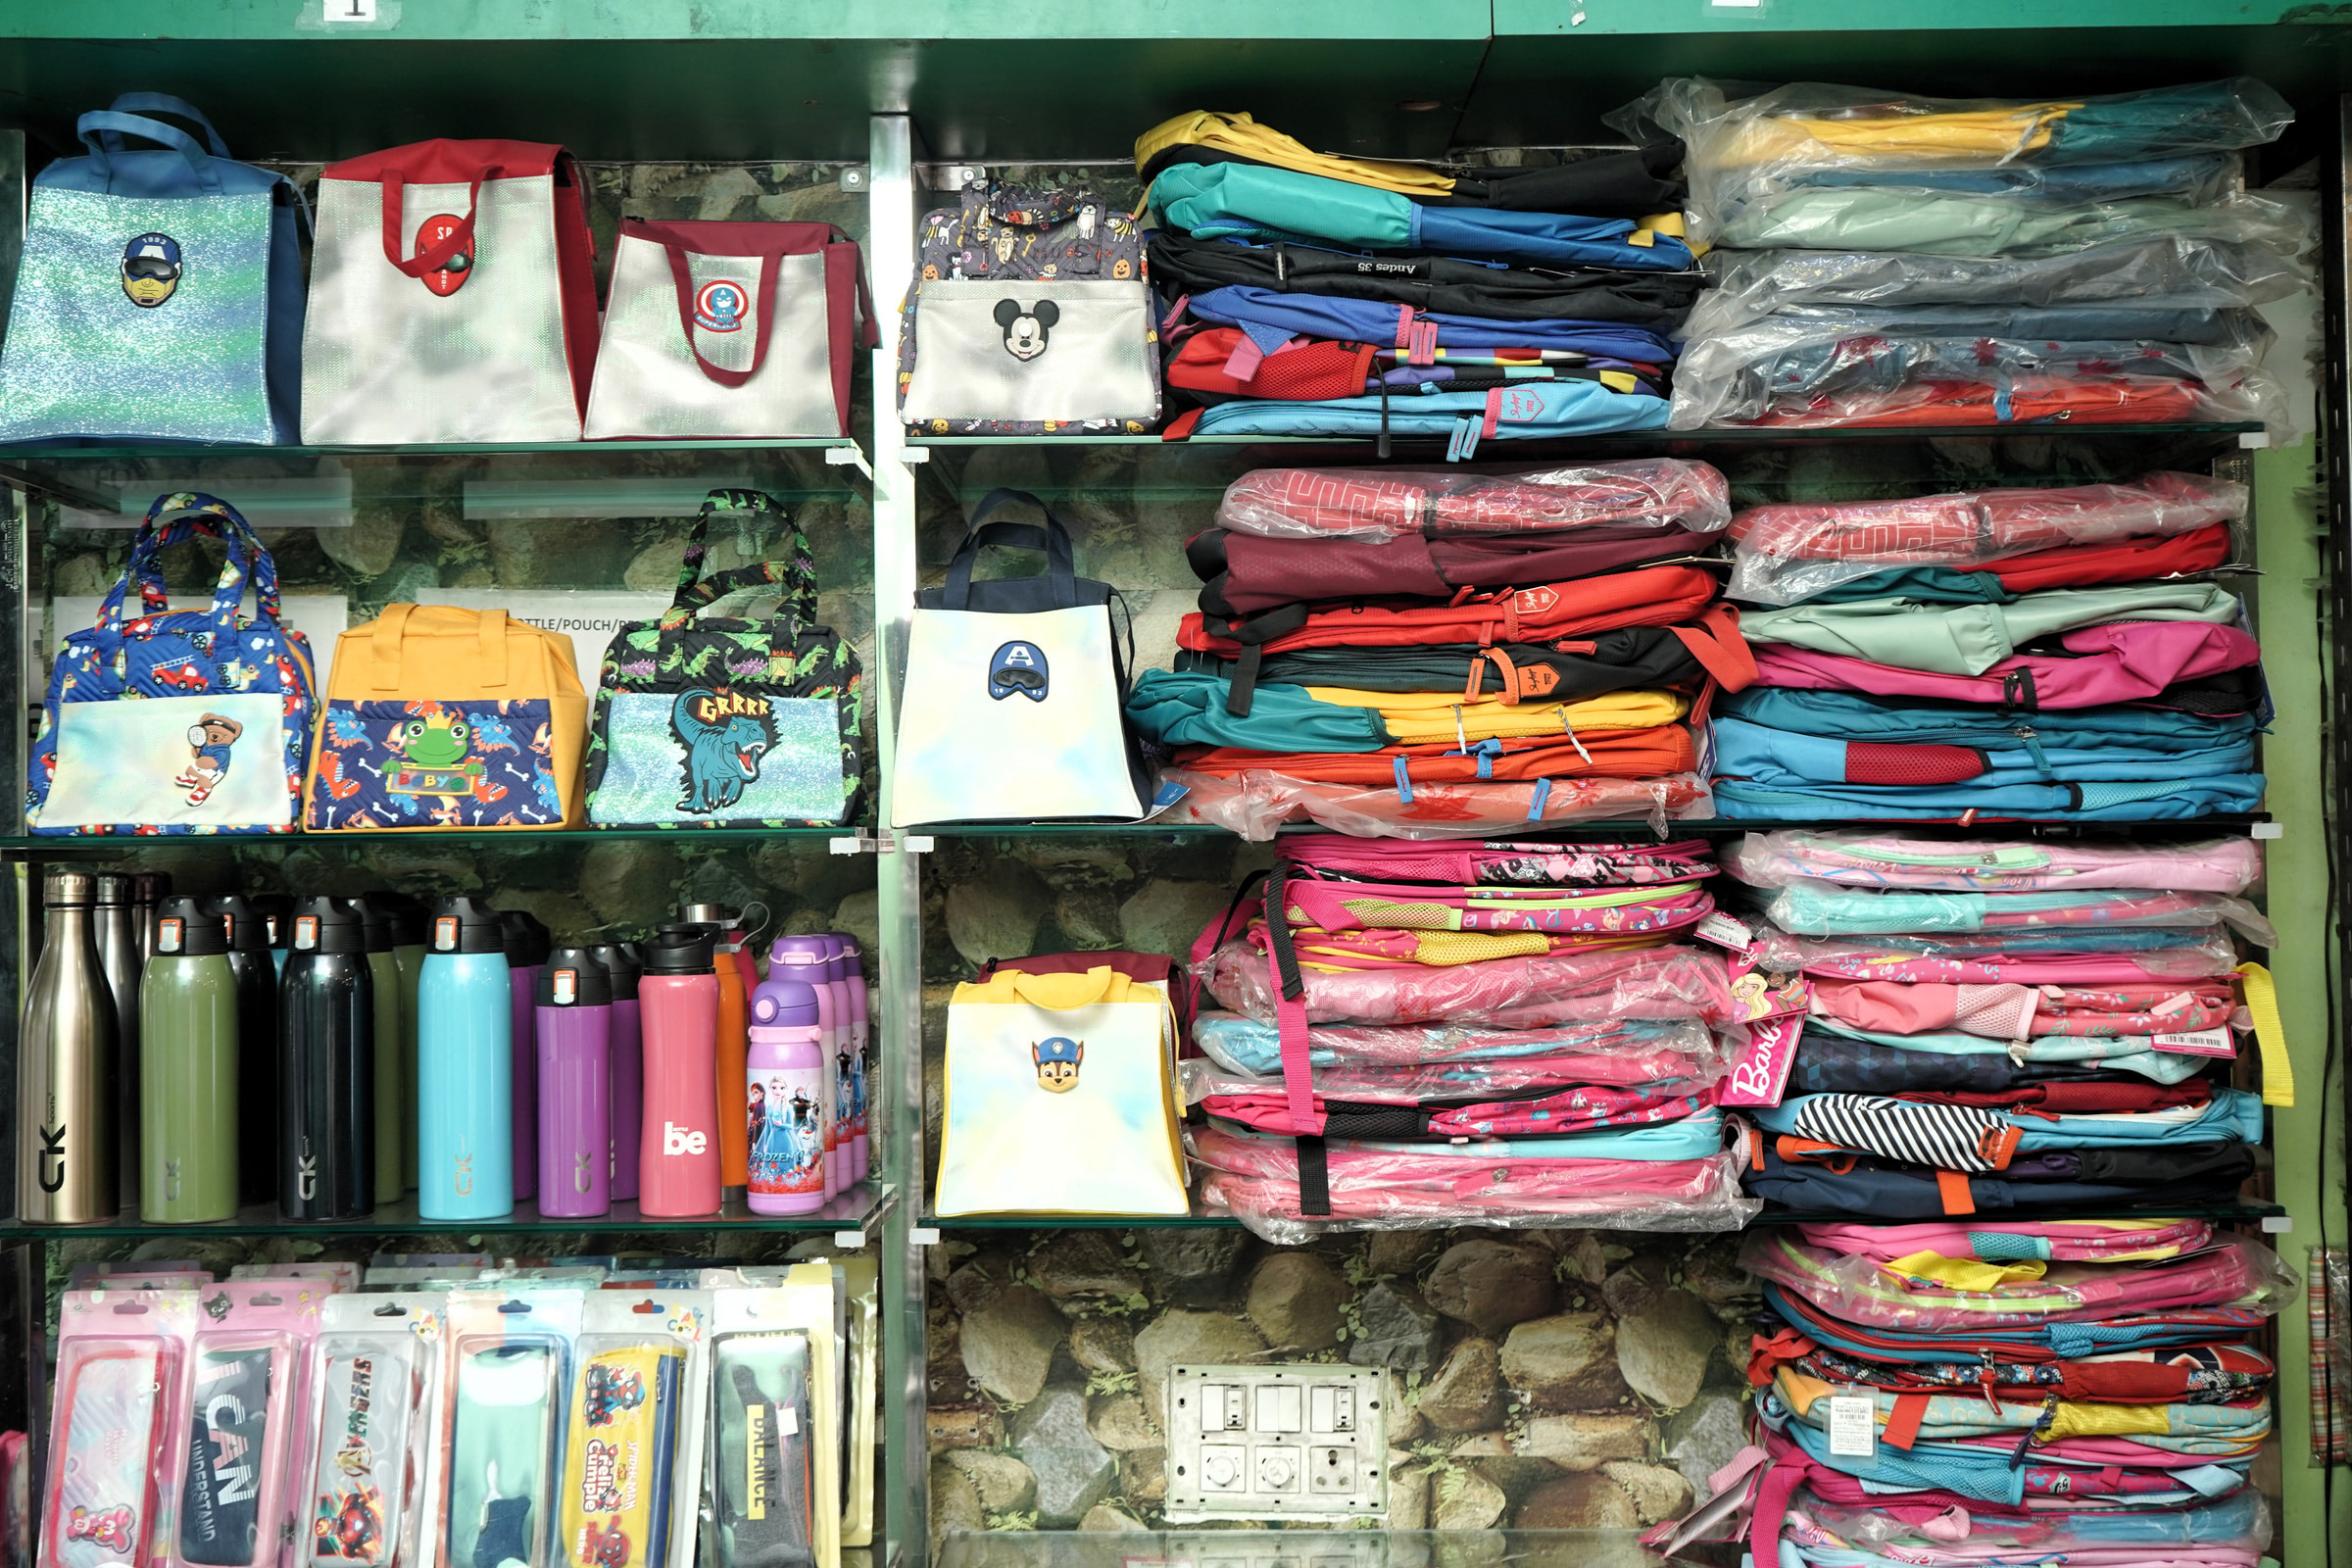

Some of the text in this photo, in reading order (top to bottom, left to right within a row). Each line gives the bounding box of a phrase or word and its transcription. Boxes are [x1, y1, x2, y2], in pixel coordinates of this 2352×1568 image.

[1357, 262, 1417, 274] Andes 35
[663, 1121, 707, 1155] be
[206, 1395, 255, 1506] CAN
[192, 1439, 217, 1544] UNDERSTAND
